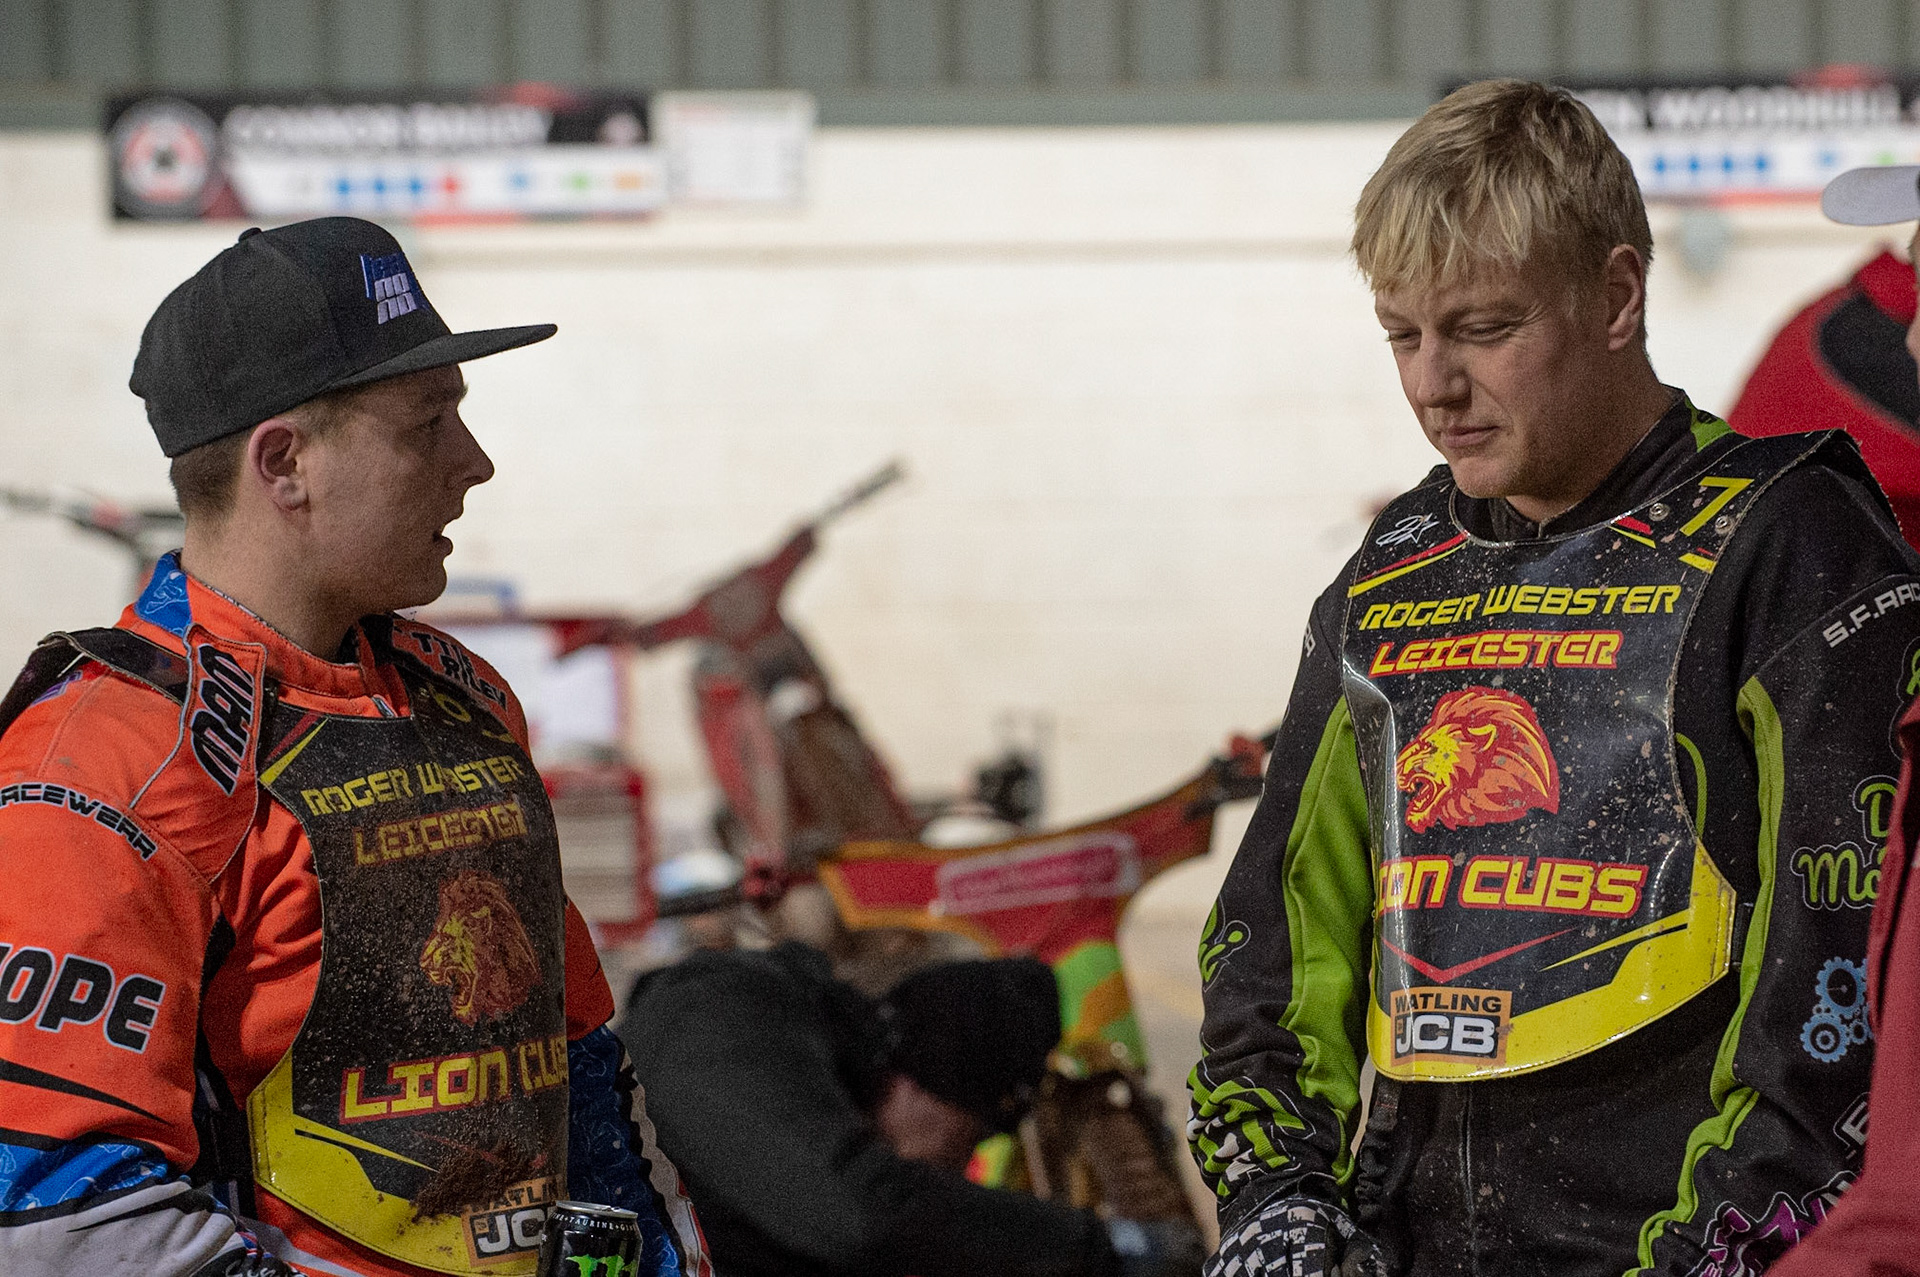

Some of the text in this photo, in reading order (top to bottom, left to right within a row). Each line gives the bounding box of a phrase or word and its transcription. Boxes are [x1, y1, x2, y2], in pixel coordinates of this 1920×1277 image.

[1680, 476, 1755, 537] 7
[1359, 584, 1682, 630] ROGER WEBSTER
[1369, 631, 1622, 677] LEICESTER
[300, 755, 526, 816] ROGER WSTER
[0, 783, 158, 861] ACEWEAR
[1460, 856, 1647, 917] CUBS
[1395, 992, 1502, 1013] WATLING
[1396, 1014, 1495, 1055] JCB
[341, 1048, 509, 1122] LION
[477, 1208, 547, 1254] JC
